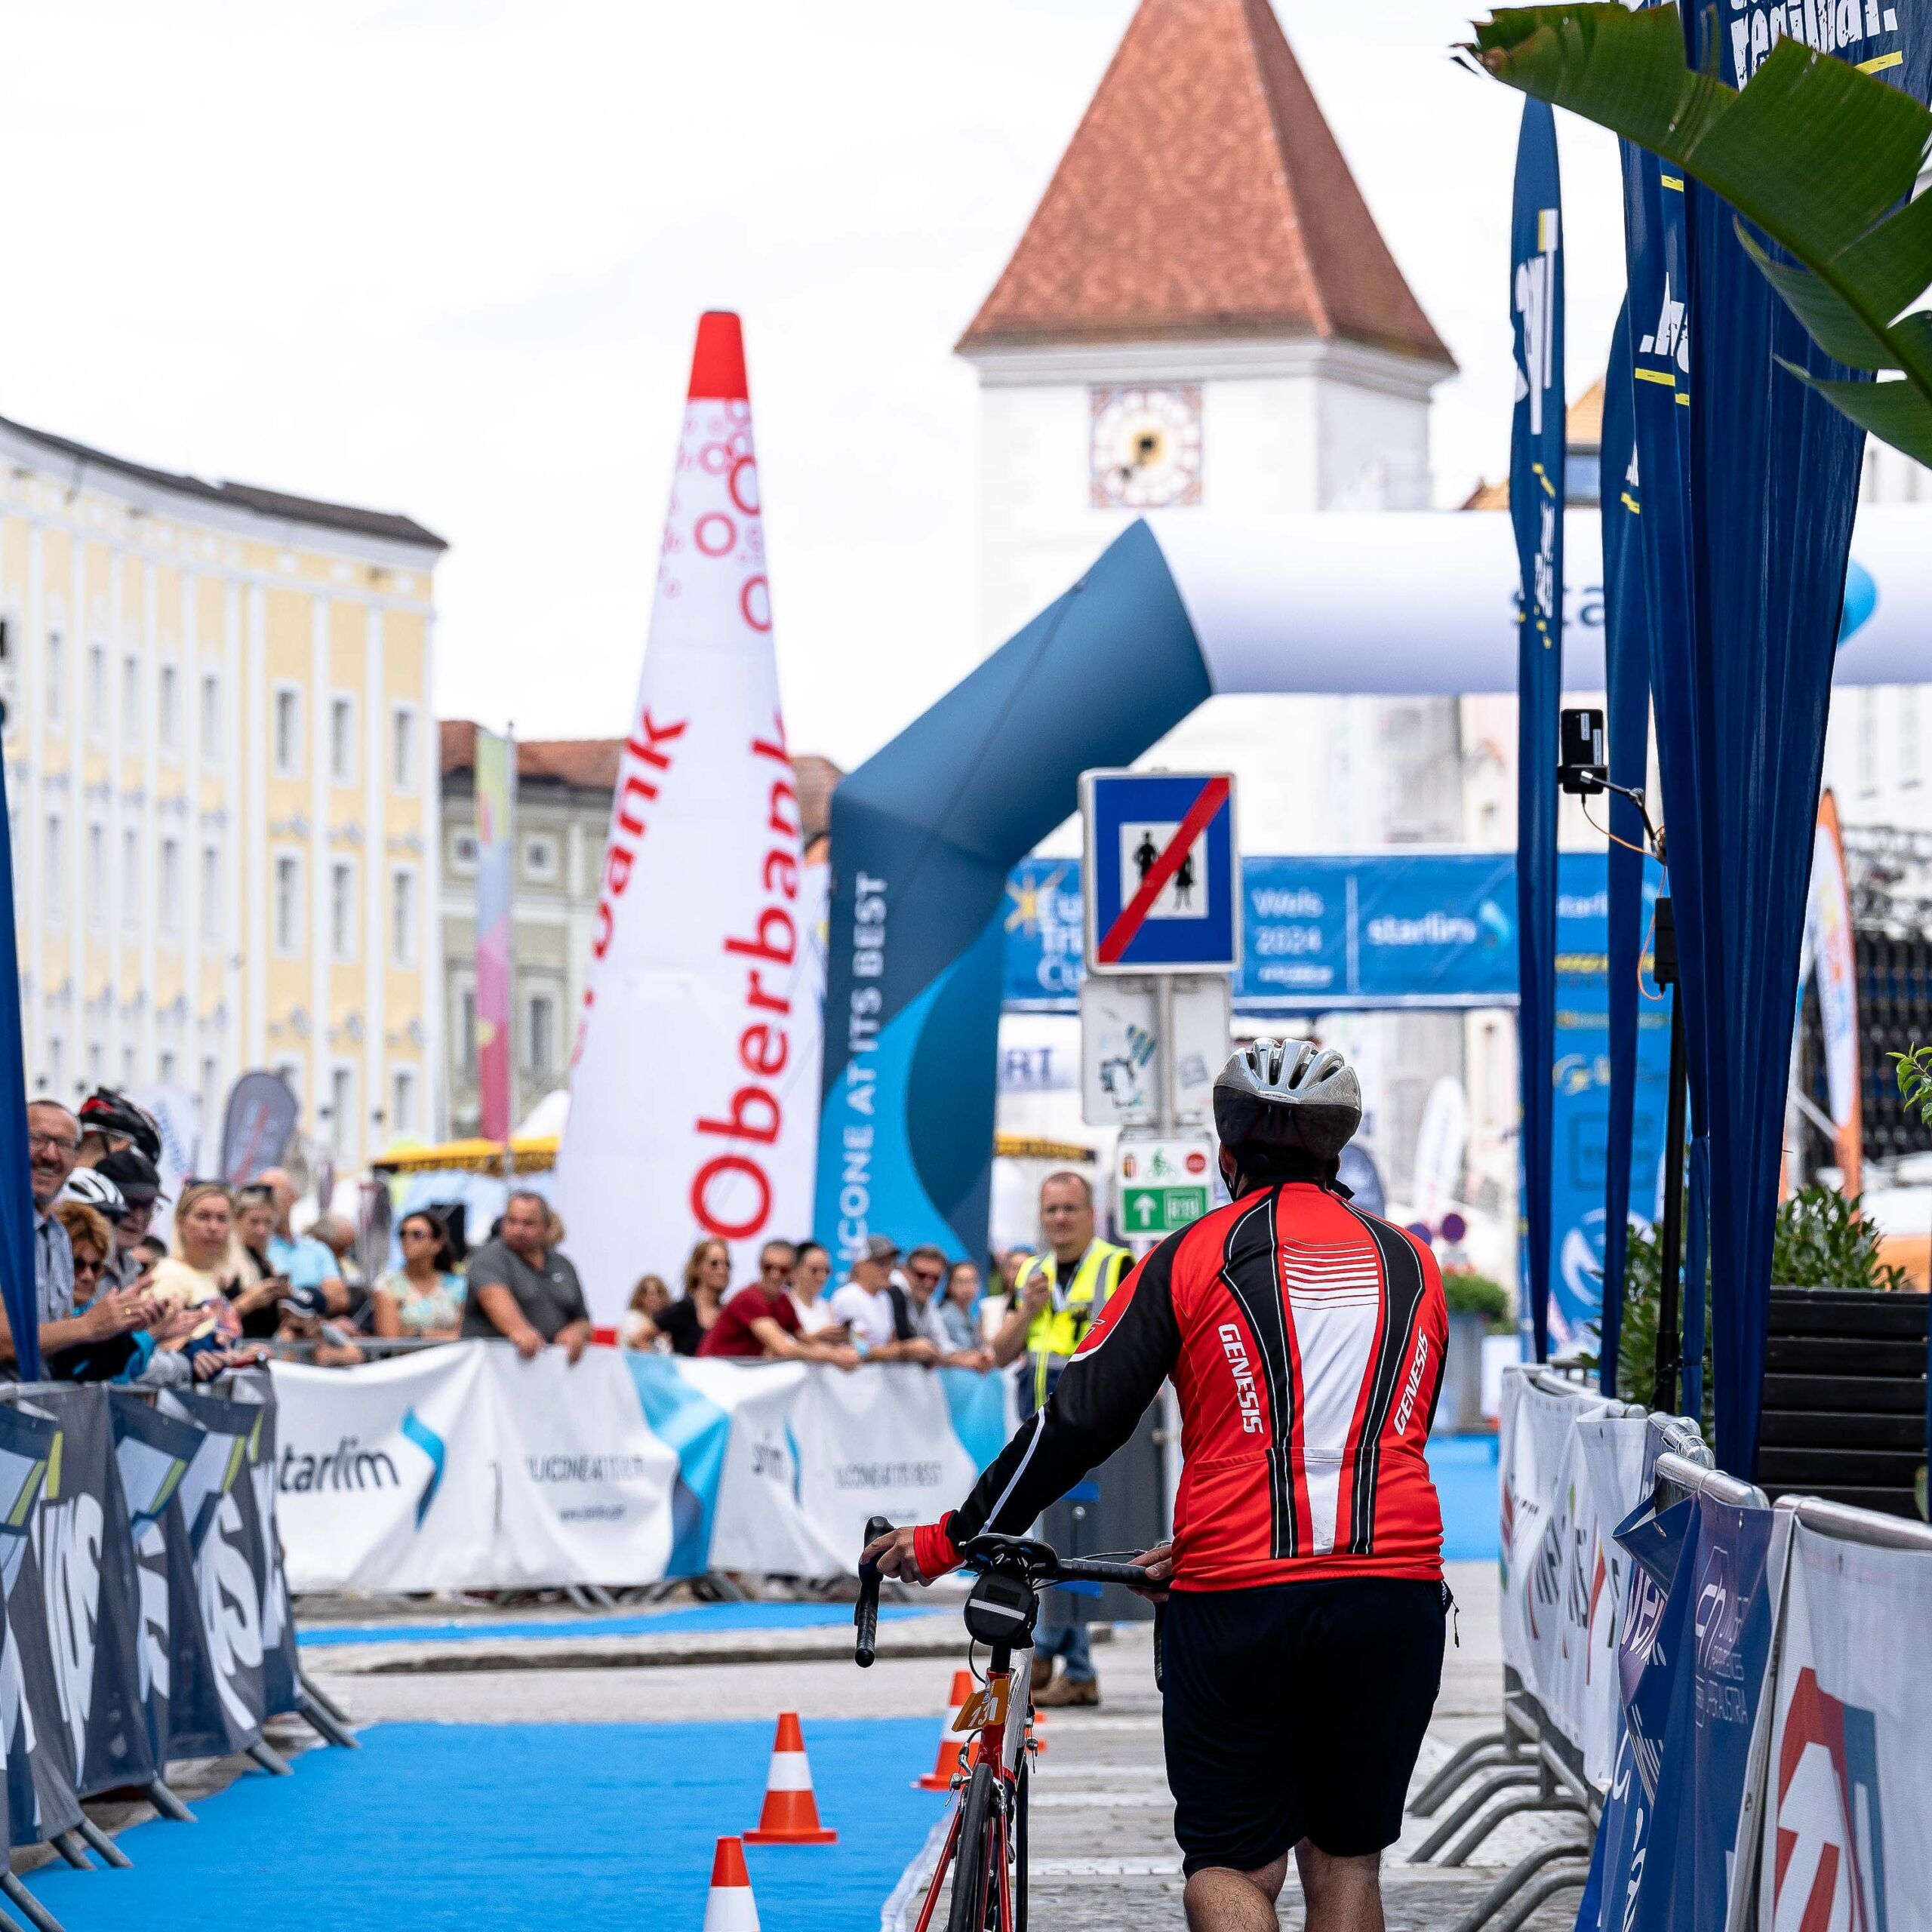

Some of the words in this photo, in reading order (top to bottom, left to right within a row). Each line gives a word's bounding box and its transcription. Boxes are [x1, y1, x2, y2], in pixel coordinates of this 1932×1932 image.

[853, 871, 889, 978] BEST
[848, 986, 884, 1052] ITS
[846, 1059, 876, 1115] AT
[1218, 1323, 1265, 1434] GENESIS
[1393, 1325, 1429, 1436] GENESIS
[278, 1436, 401, 1494] tarlim
